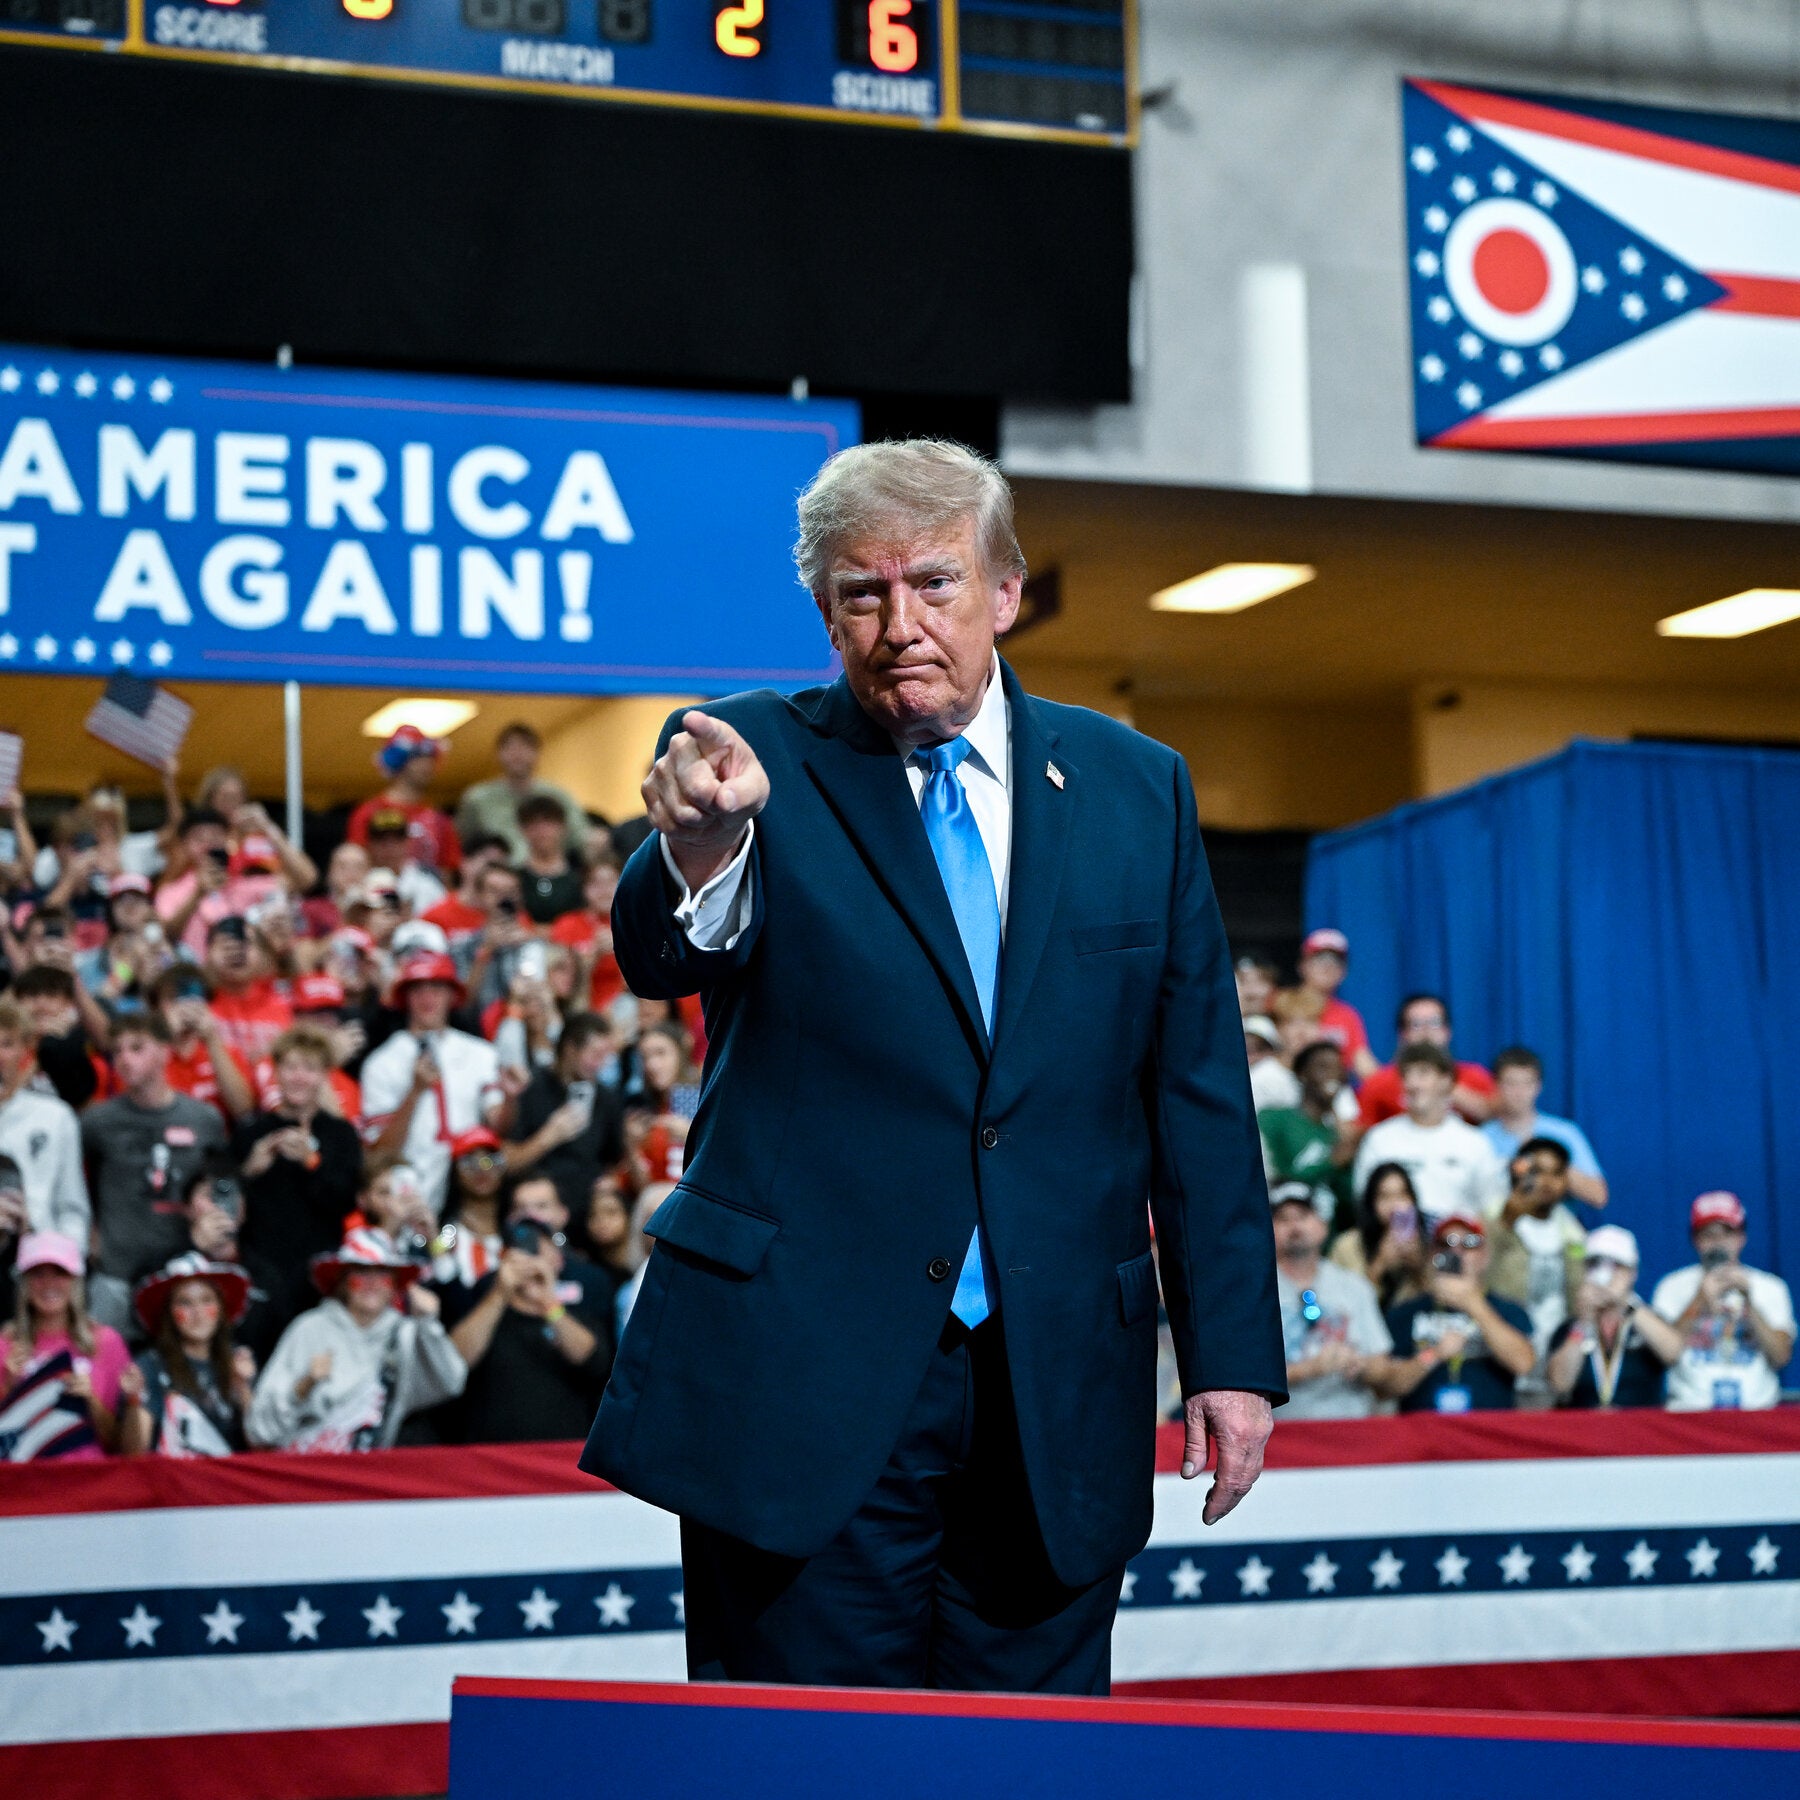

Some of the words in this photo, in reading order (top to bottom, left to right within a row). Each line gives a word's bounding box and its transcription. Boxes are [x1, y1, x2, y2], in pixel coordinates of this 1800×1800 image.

[154, 5, 267, 51] SCORE
[869, 0, 918, 72] 6
[833, 71, 936, 116] SCORE
[0, 418, 633, 544] AMERICA
[94, 530, 593, 642] AGAIN!
